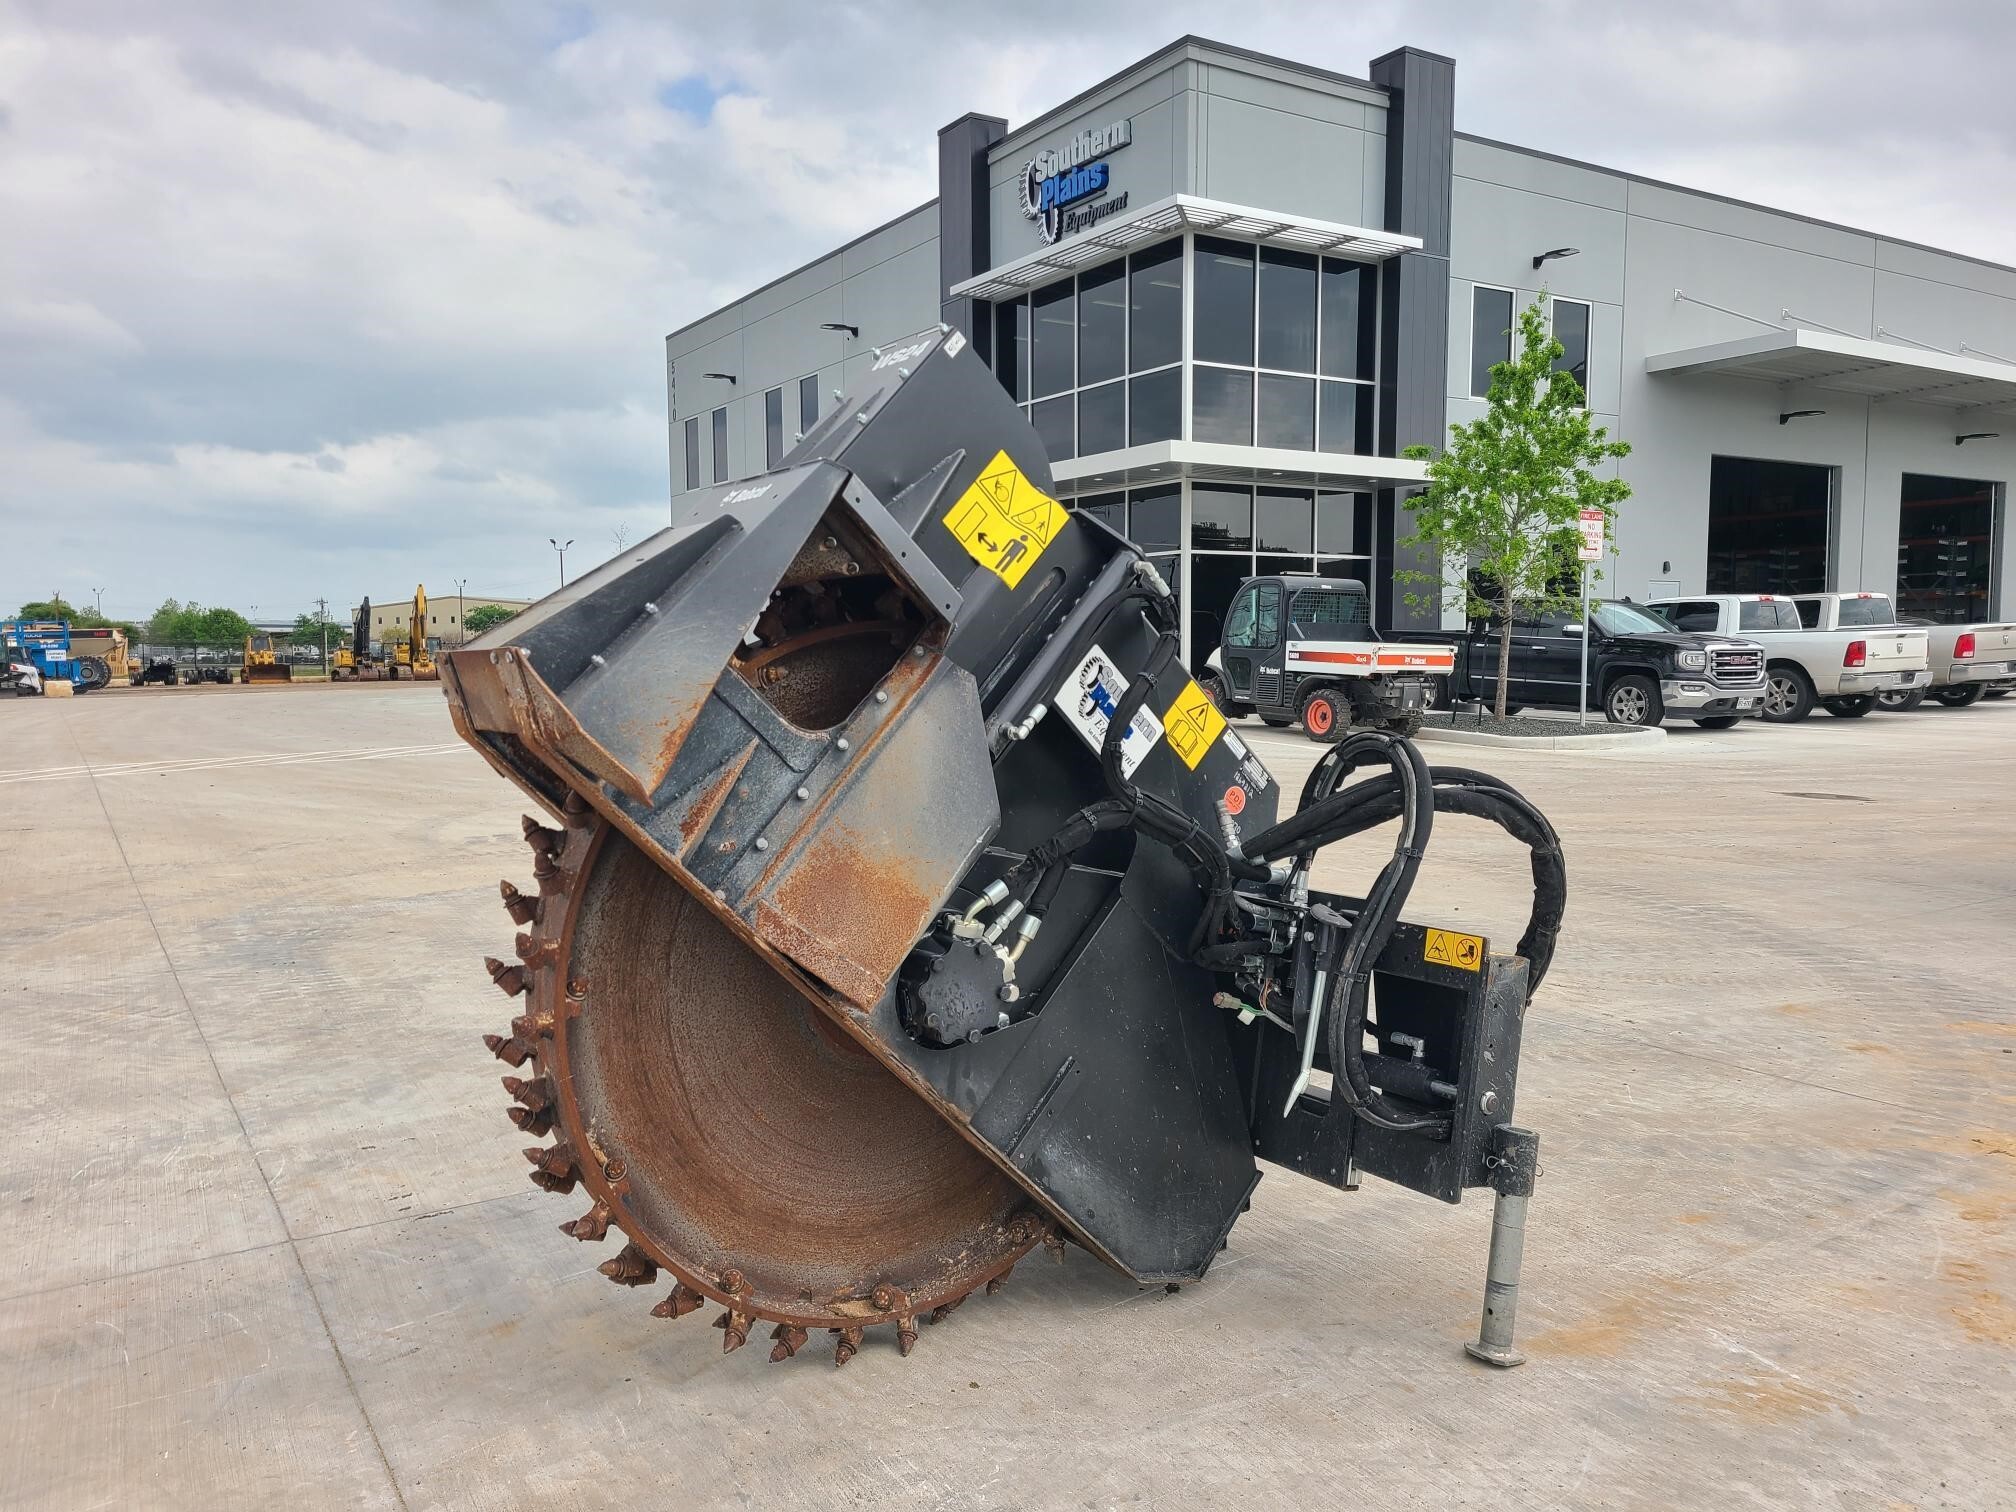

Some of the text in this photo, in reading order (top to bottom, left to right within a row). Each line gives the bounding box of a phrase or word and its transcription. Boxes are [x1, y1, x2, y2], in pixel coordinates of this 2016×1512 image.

[1035, 119, 1131, 183] Southern
[1041, 161, 1108, 212] Plains
[1064, 191, 1128, 233] Equipment
[1730, 656, 1752, 664] GMC
[1098, 665, 1157, 743] Souern
